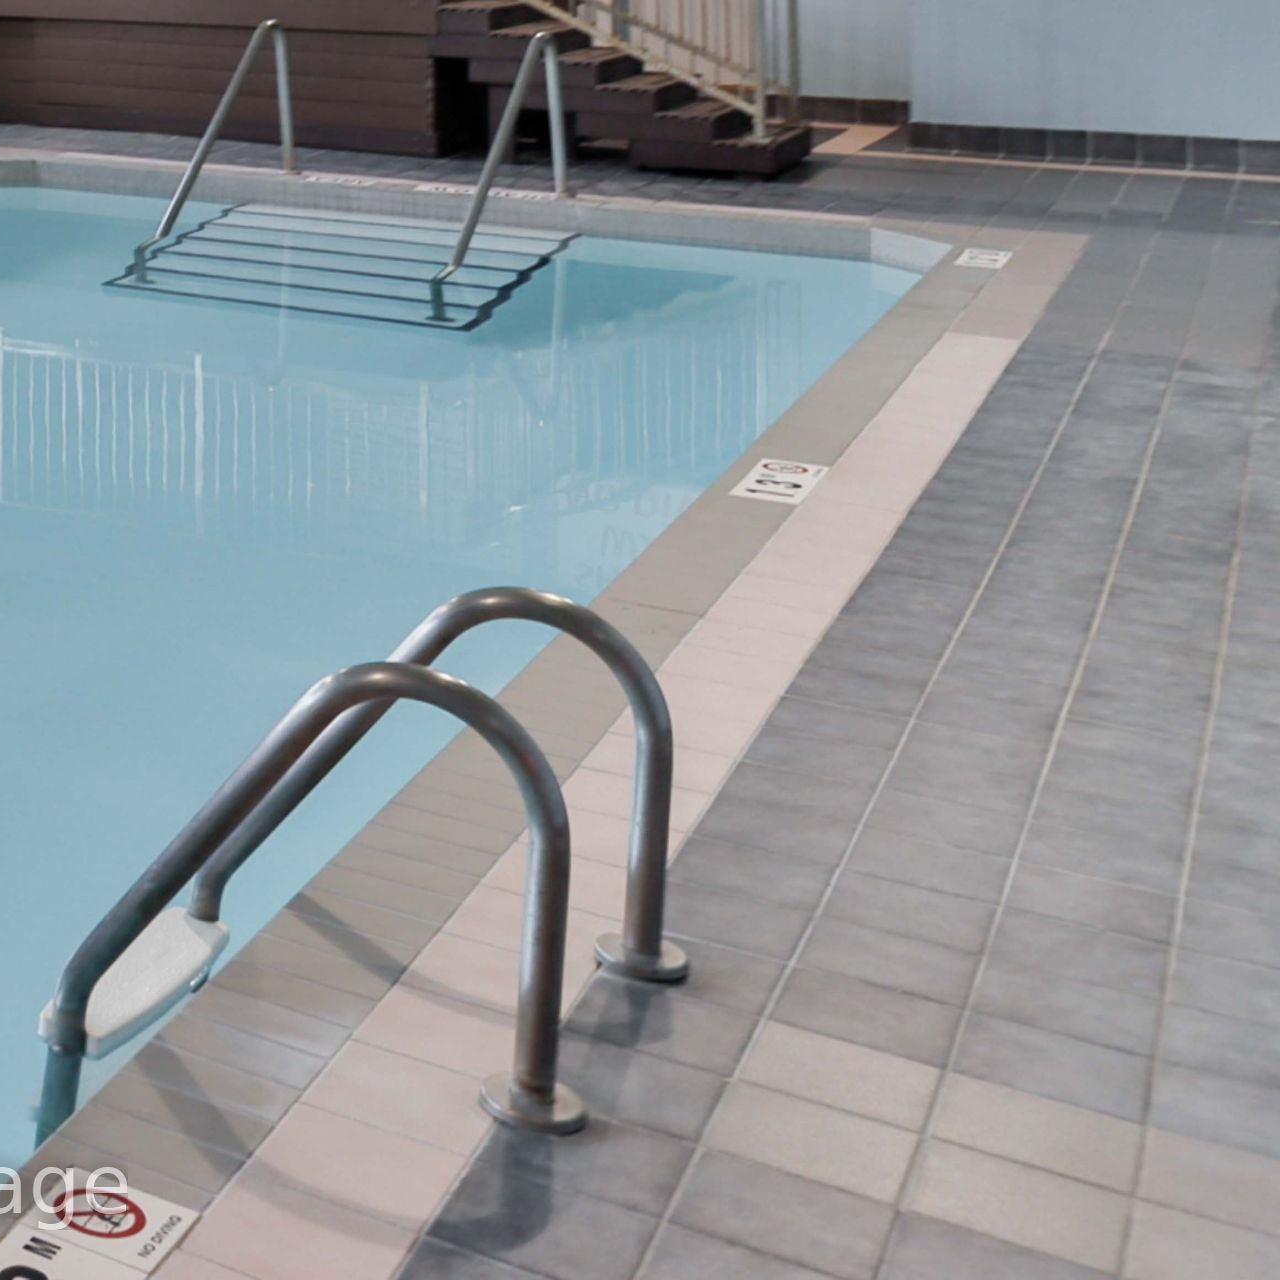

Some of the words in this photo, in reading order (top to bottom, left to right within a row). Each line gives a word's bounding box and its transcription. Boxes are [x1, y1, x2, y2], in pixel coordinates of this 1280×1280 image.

[22, 1236, 62, 1261] M
[137, 1243, 154, 1259] NO
[151, 1214, 182, 1246] DIVING
